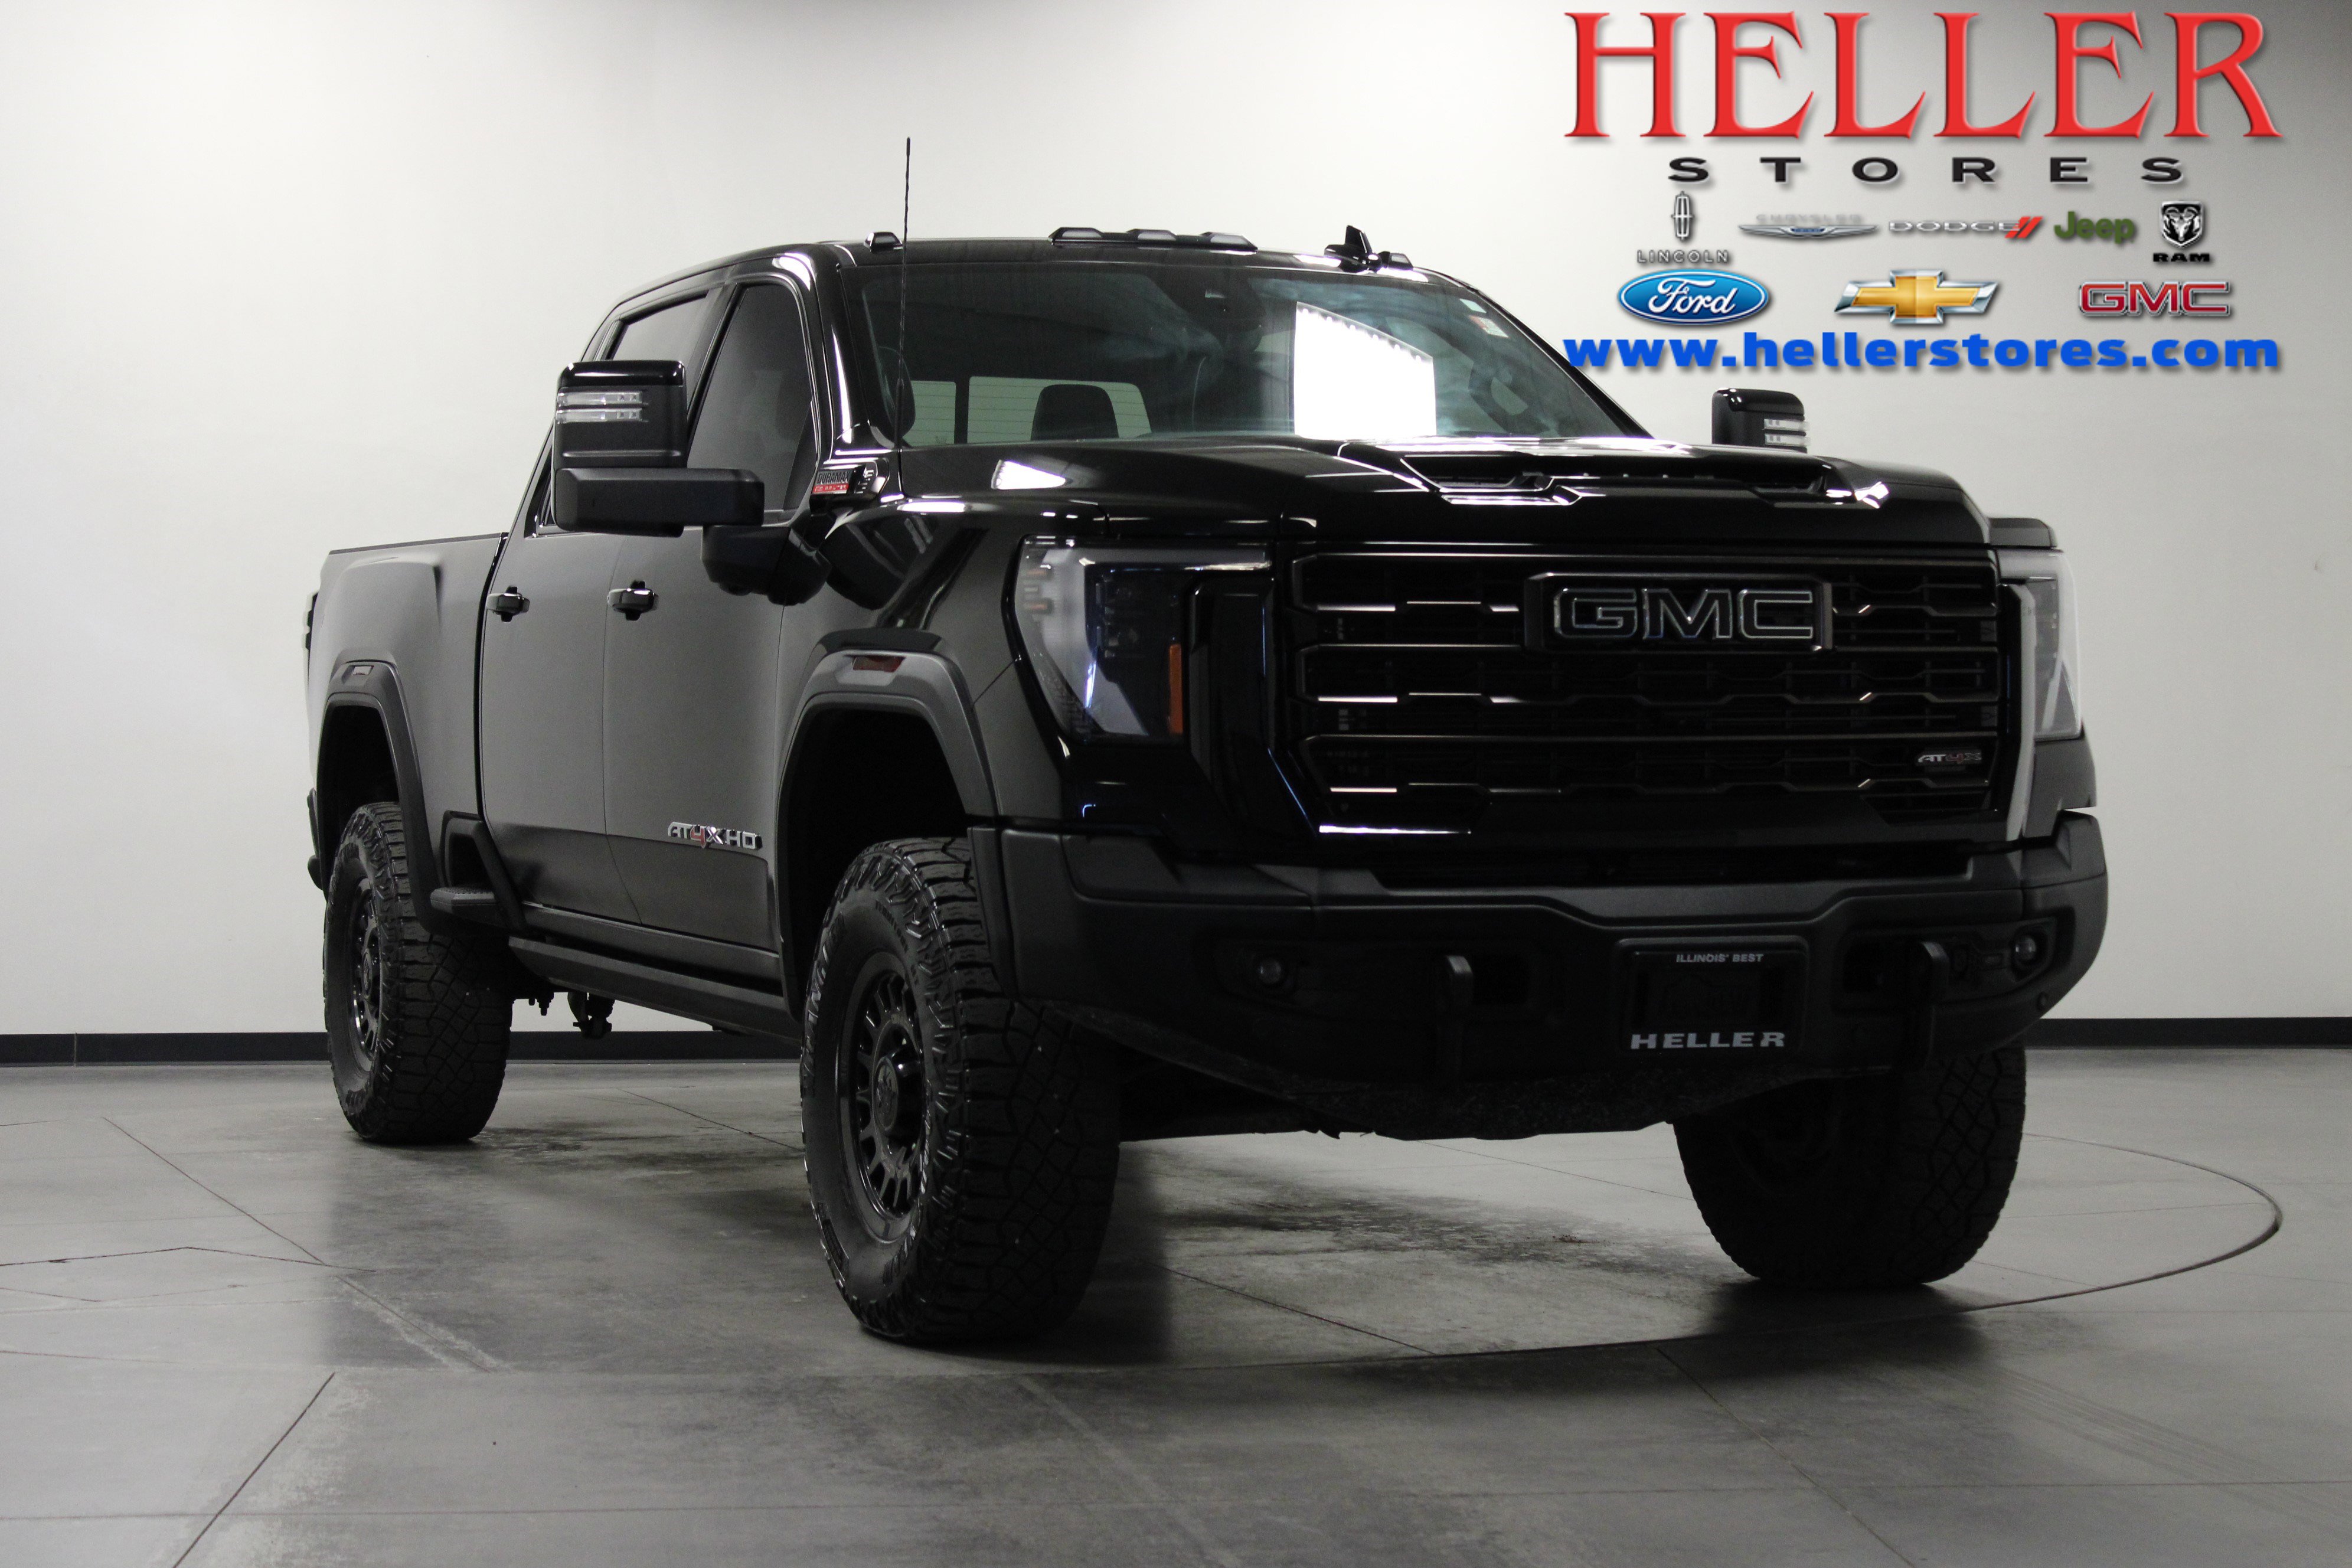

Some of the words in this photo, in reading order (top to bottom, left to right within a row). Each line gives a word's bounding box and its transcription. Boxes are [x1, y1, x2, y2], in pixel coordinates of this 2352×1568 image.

[1553, 588, 1814, 639] GMC
[1917, 752, 1982, 765] AT4X
[1675, 953, 1730, 963] ILLINOIS'
[1732, 953, 1764, 962] BEST
[1630, 1031, 1785, 1050] HELLER
